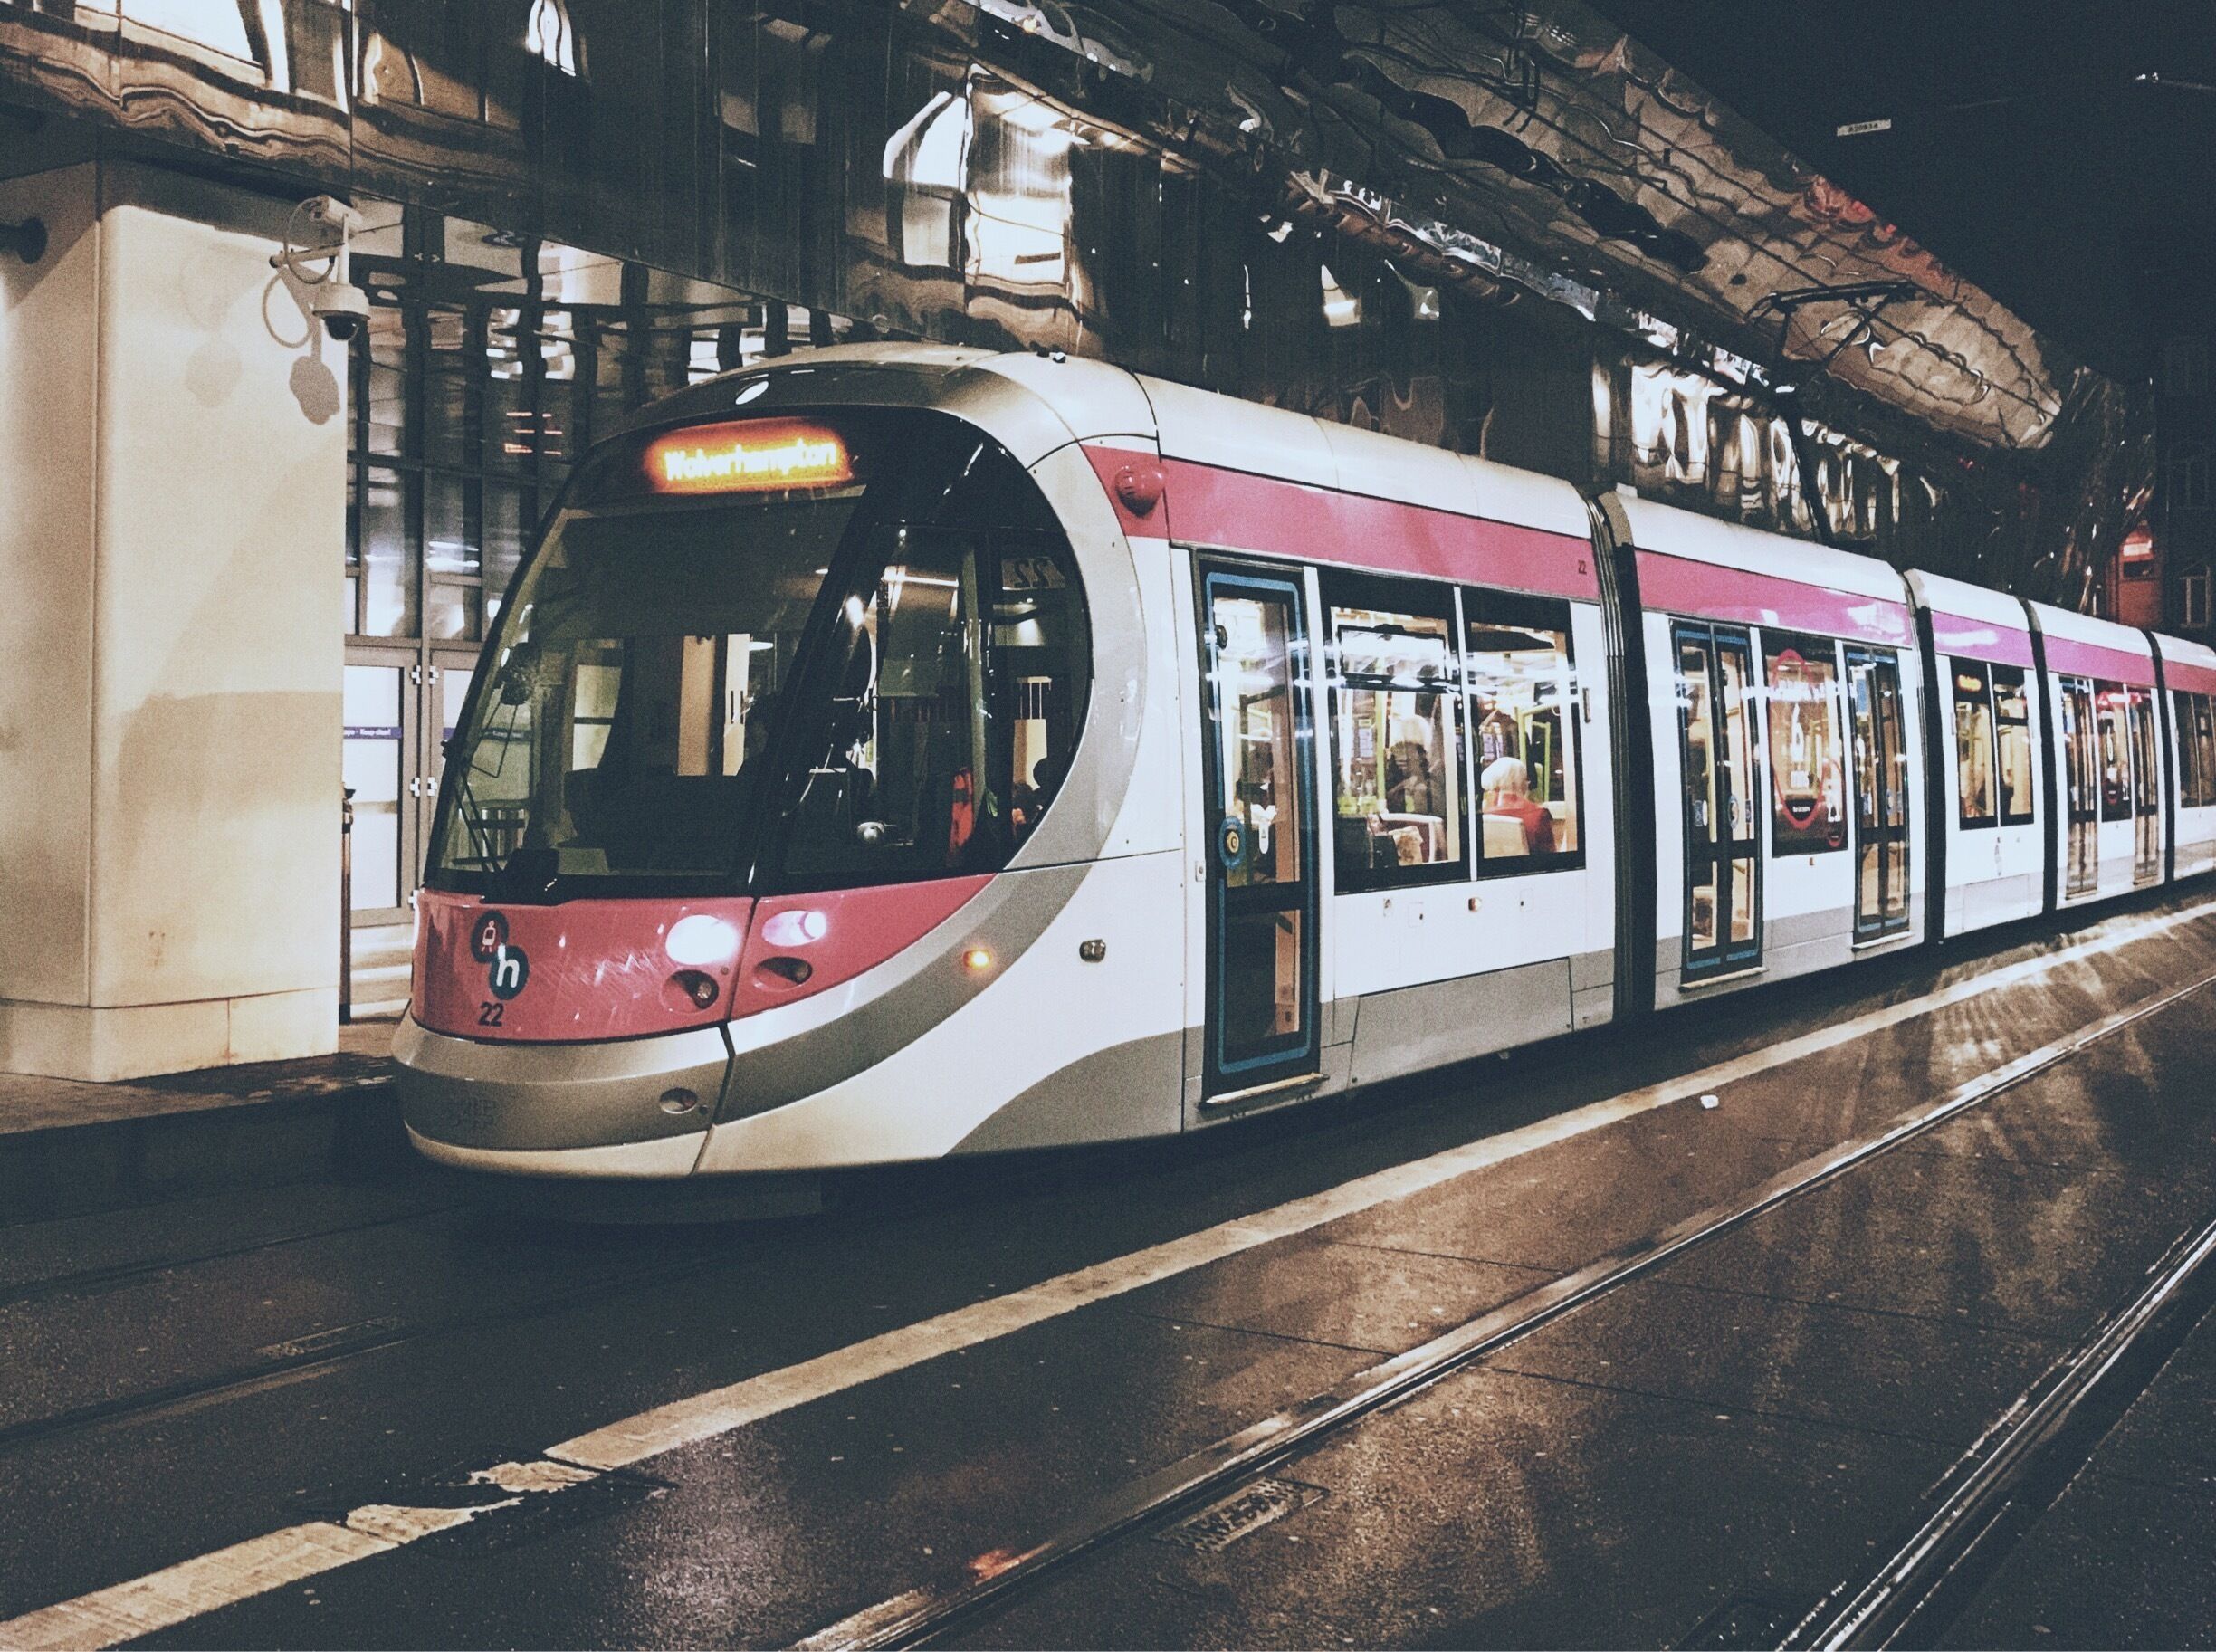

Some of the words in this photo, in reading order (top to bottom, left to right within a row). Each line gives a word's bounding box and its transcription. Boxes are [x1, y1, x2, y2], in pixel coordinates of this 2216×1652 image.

[665, 438, 836, 481] Wolverhampton
[1578, 559, 1587, 575] 22
[478, 1001, 504, 1027] 22
